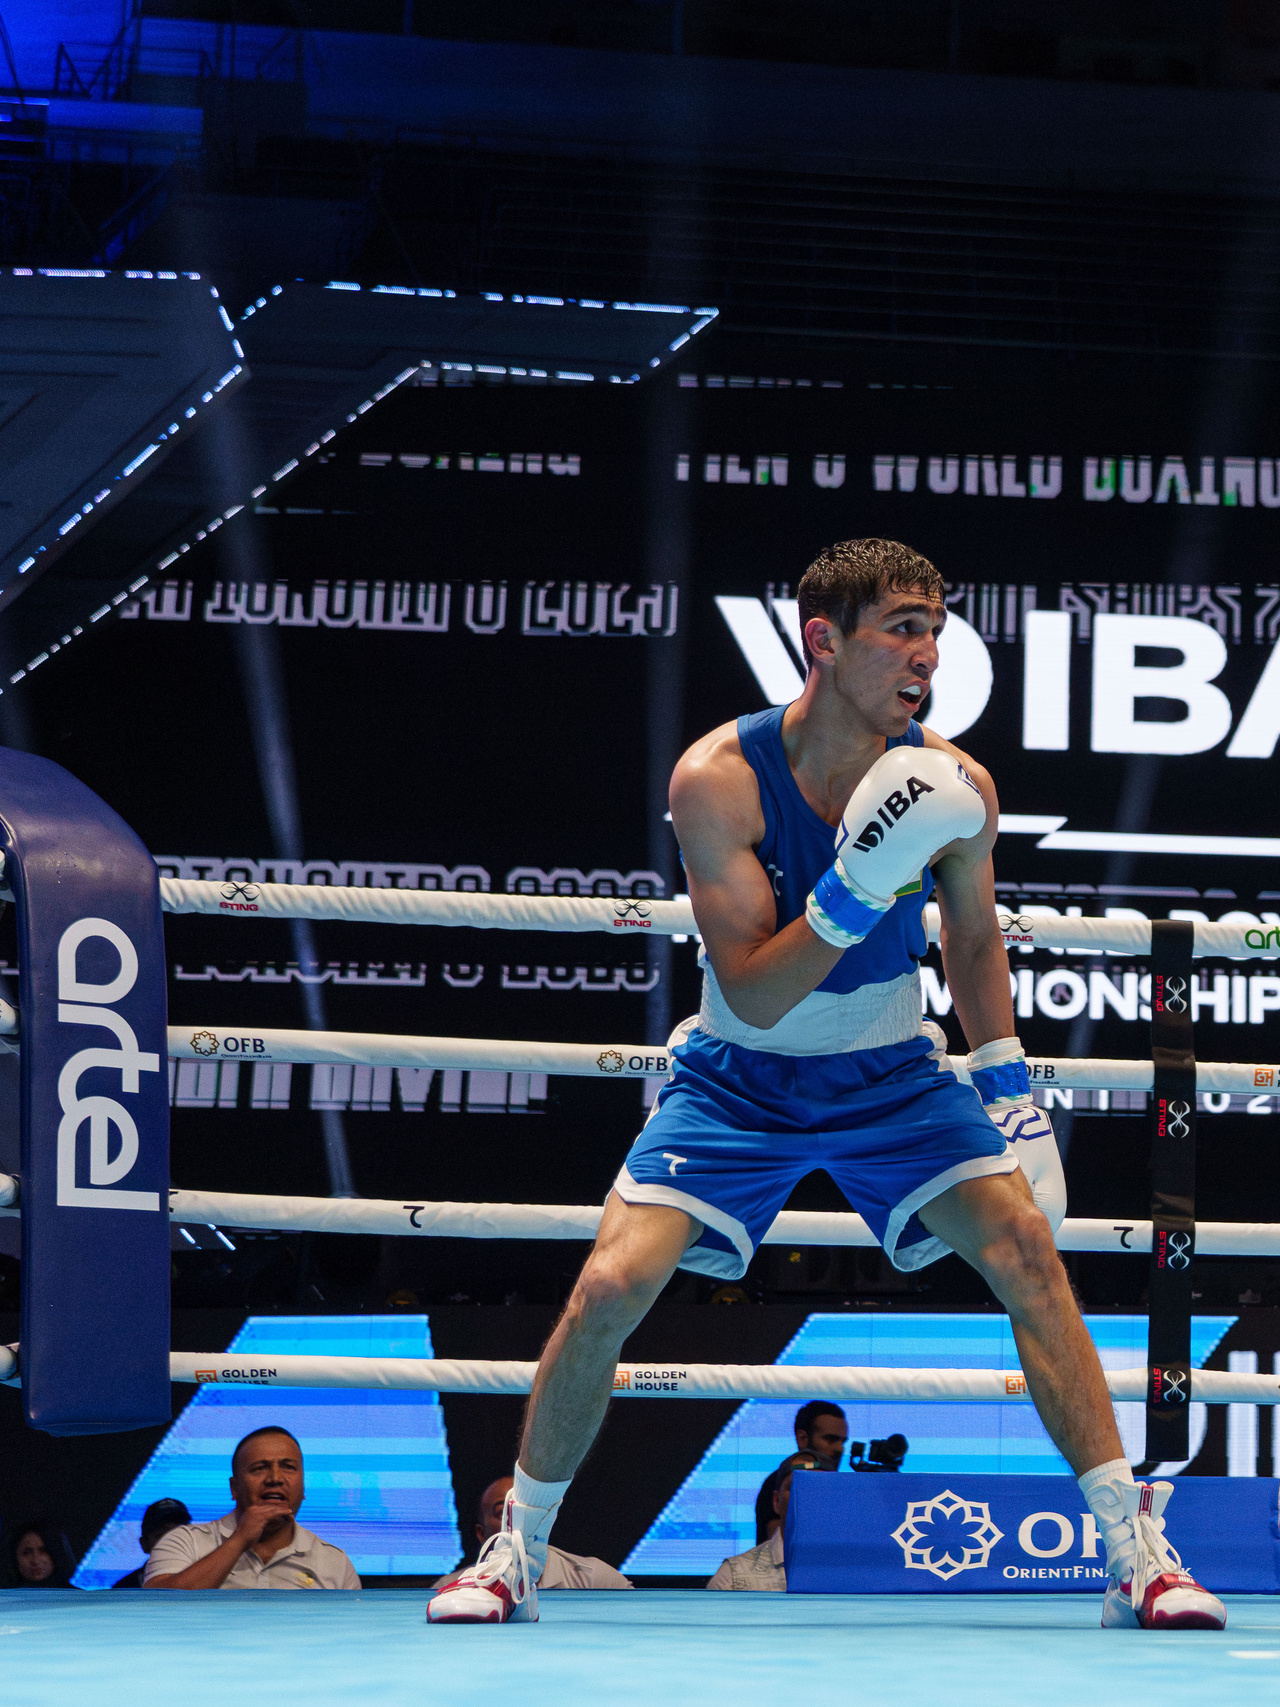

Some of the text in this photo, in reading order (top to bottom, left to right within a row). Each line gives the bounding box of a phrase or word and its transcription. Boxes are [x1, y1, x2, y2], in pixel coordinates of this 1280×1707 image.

[877, 776, 936, 829] IBA
[219, 901, 258, 911] STING
[613, 919, 651, 928] STING
[1156, 975, 1164, 1012] STING
[224, 1037, 266, 1053] OFB
[57, 917, 160, 1211] artel
[628, 1056, 668, 1071] OFB
[1158, 1098, 1167, 1137] STING
[1158, 1230, 1166, 1269] STING
[222, 1369, 277, 1378] GOLDEN
[635, 1371, 687, 1379] GOLDEN
[635, 1382, 679, 1391] HOUSE
[1153, 1368, 1162, 1403] STING
